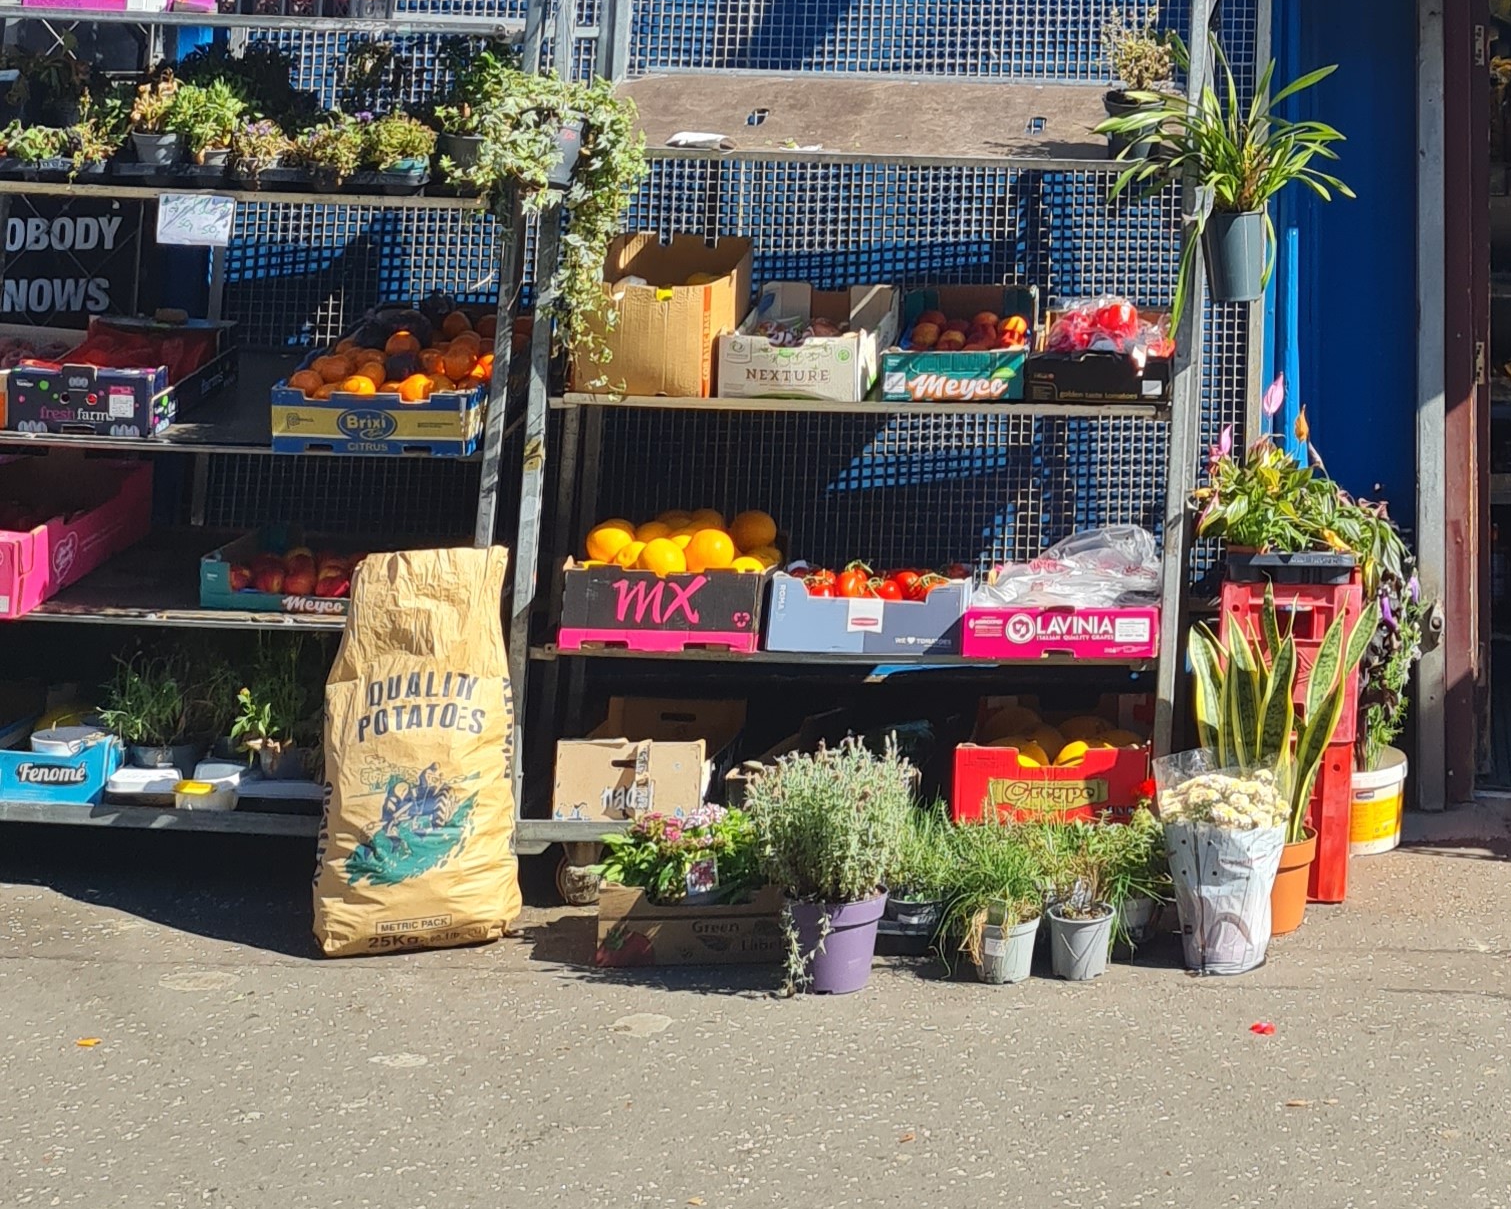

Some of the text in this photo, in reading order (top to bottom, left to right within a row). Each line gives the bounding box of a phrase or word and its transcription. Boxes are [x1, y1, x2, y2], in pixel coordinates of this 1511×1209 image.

[745, 368, 830, 383] NEXTURE
[909, 374, 1009, 400] Meyco
[40, 407, 76, 421] fresh
[346, 412, 386, 429] Brixi
[347, 443, 388, 452] CITRUS
[282, 596, 345, 613] Meyco
[1037, 616, 1114, 635] LAVINIA
[369, 671, 480, 707] QUALITY
[358, 702, 486, 743] POTATOES
[19, 761, 87, 782] Fenomé
[380, 918, 448, 932] METRIC PACK
